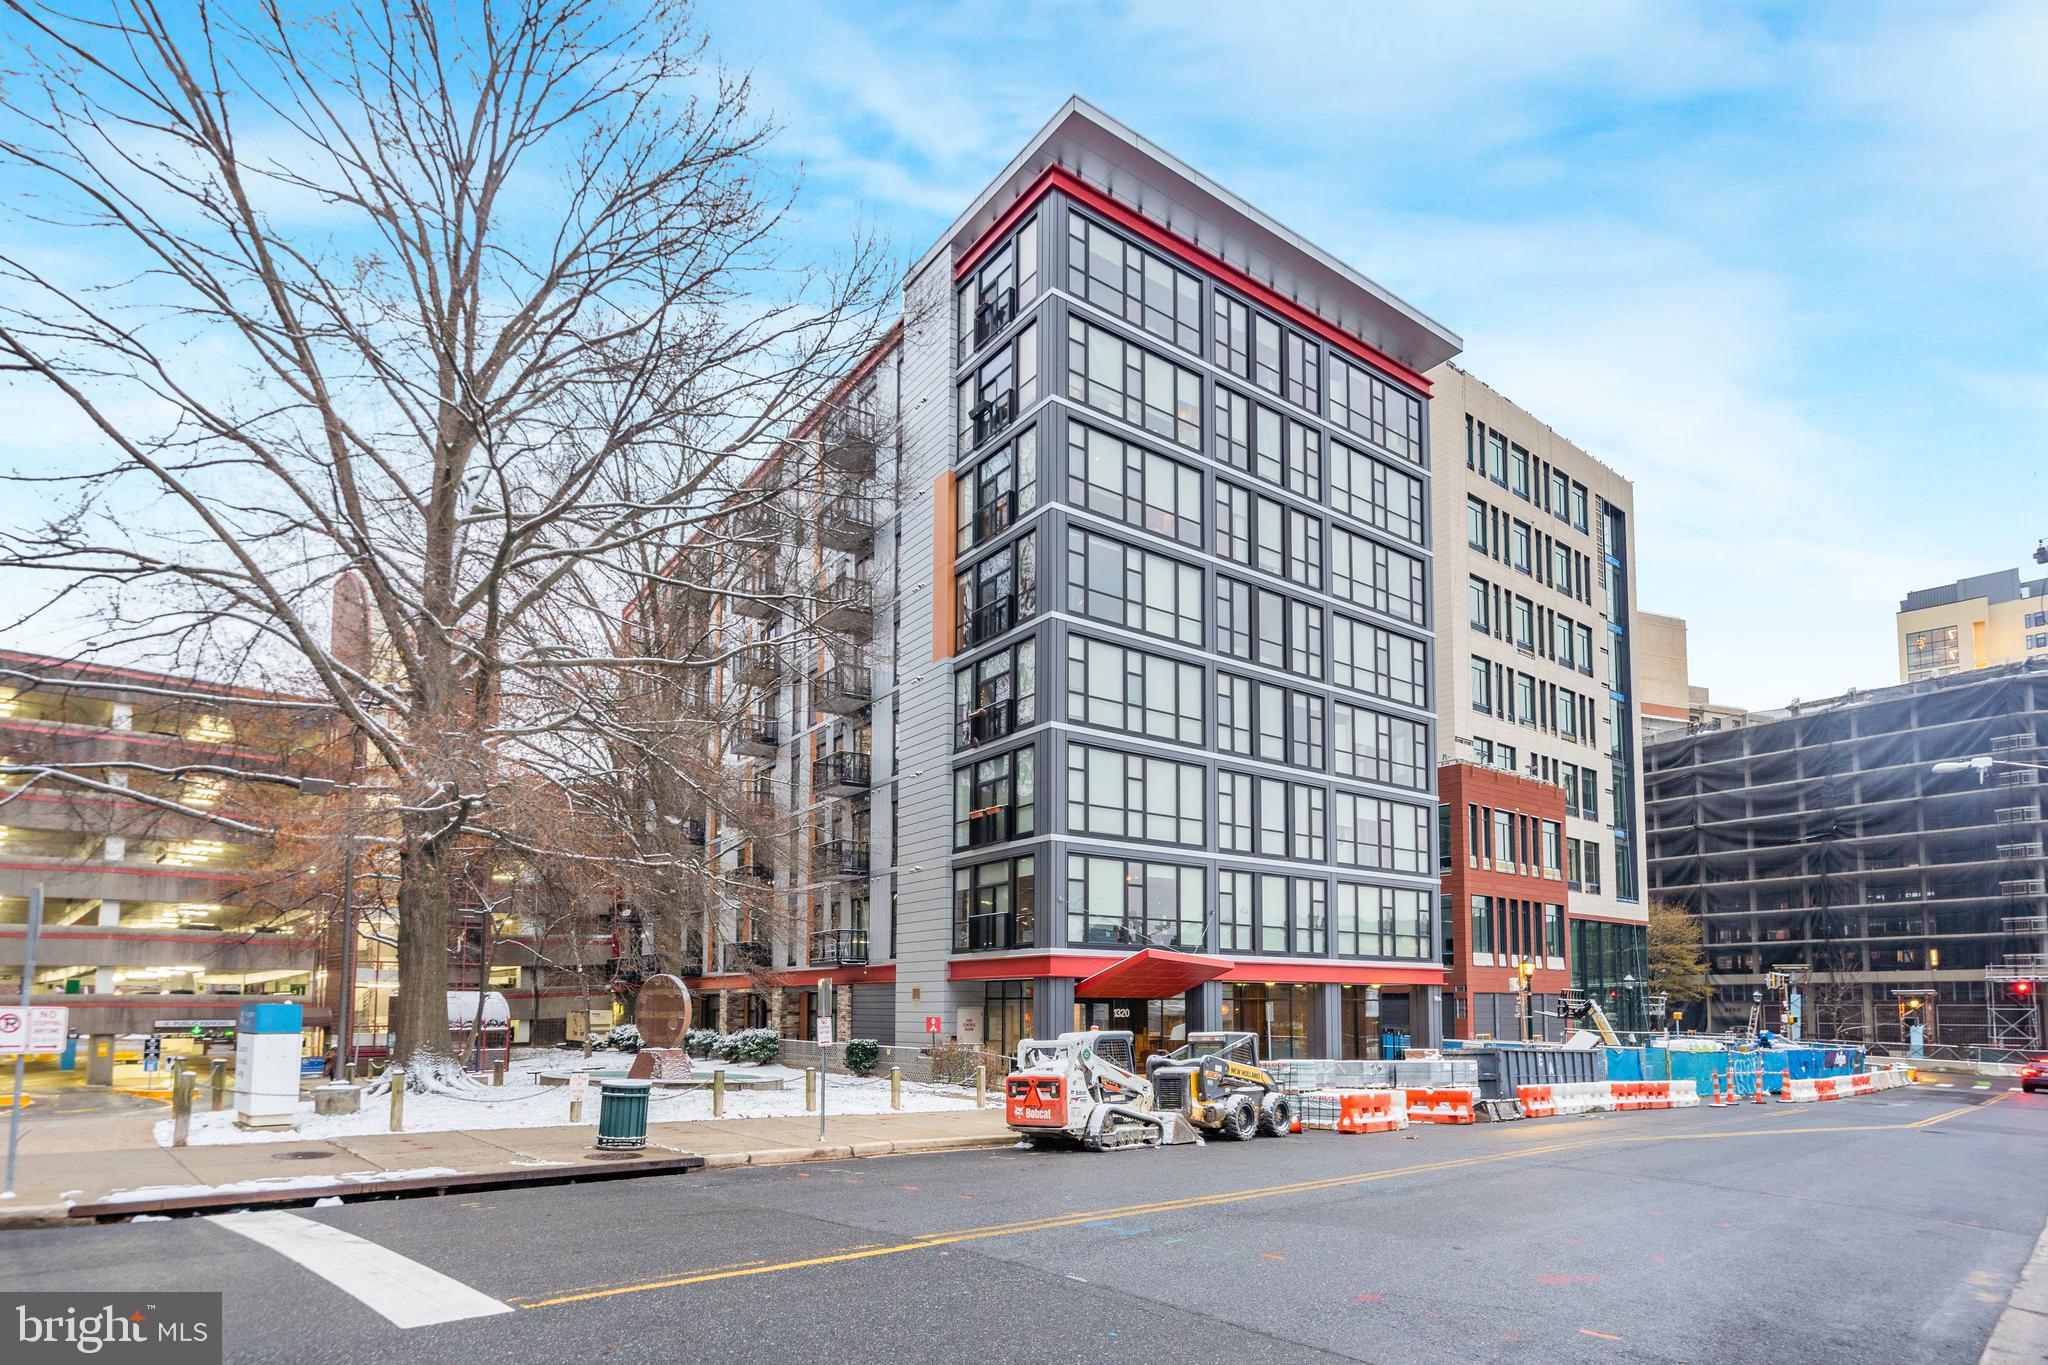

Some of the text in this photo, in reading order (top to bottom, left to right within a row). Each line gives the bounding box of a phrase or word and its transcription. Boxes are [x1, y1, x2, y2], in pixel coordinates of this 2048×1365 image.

[40, 1010, 57, 1019] NO
[1113, 1008, 1130, 1018] 1320
[1230, 1067, 1261, 1080] NEW HOLLAND
[1025, 1107, 1052, 1120] Bobcat
